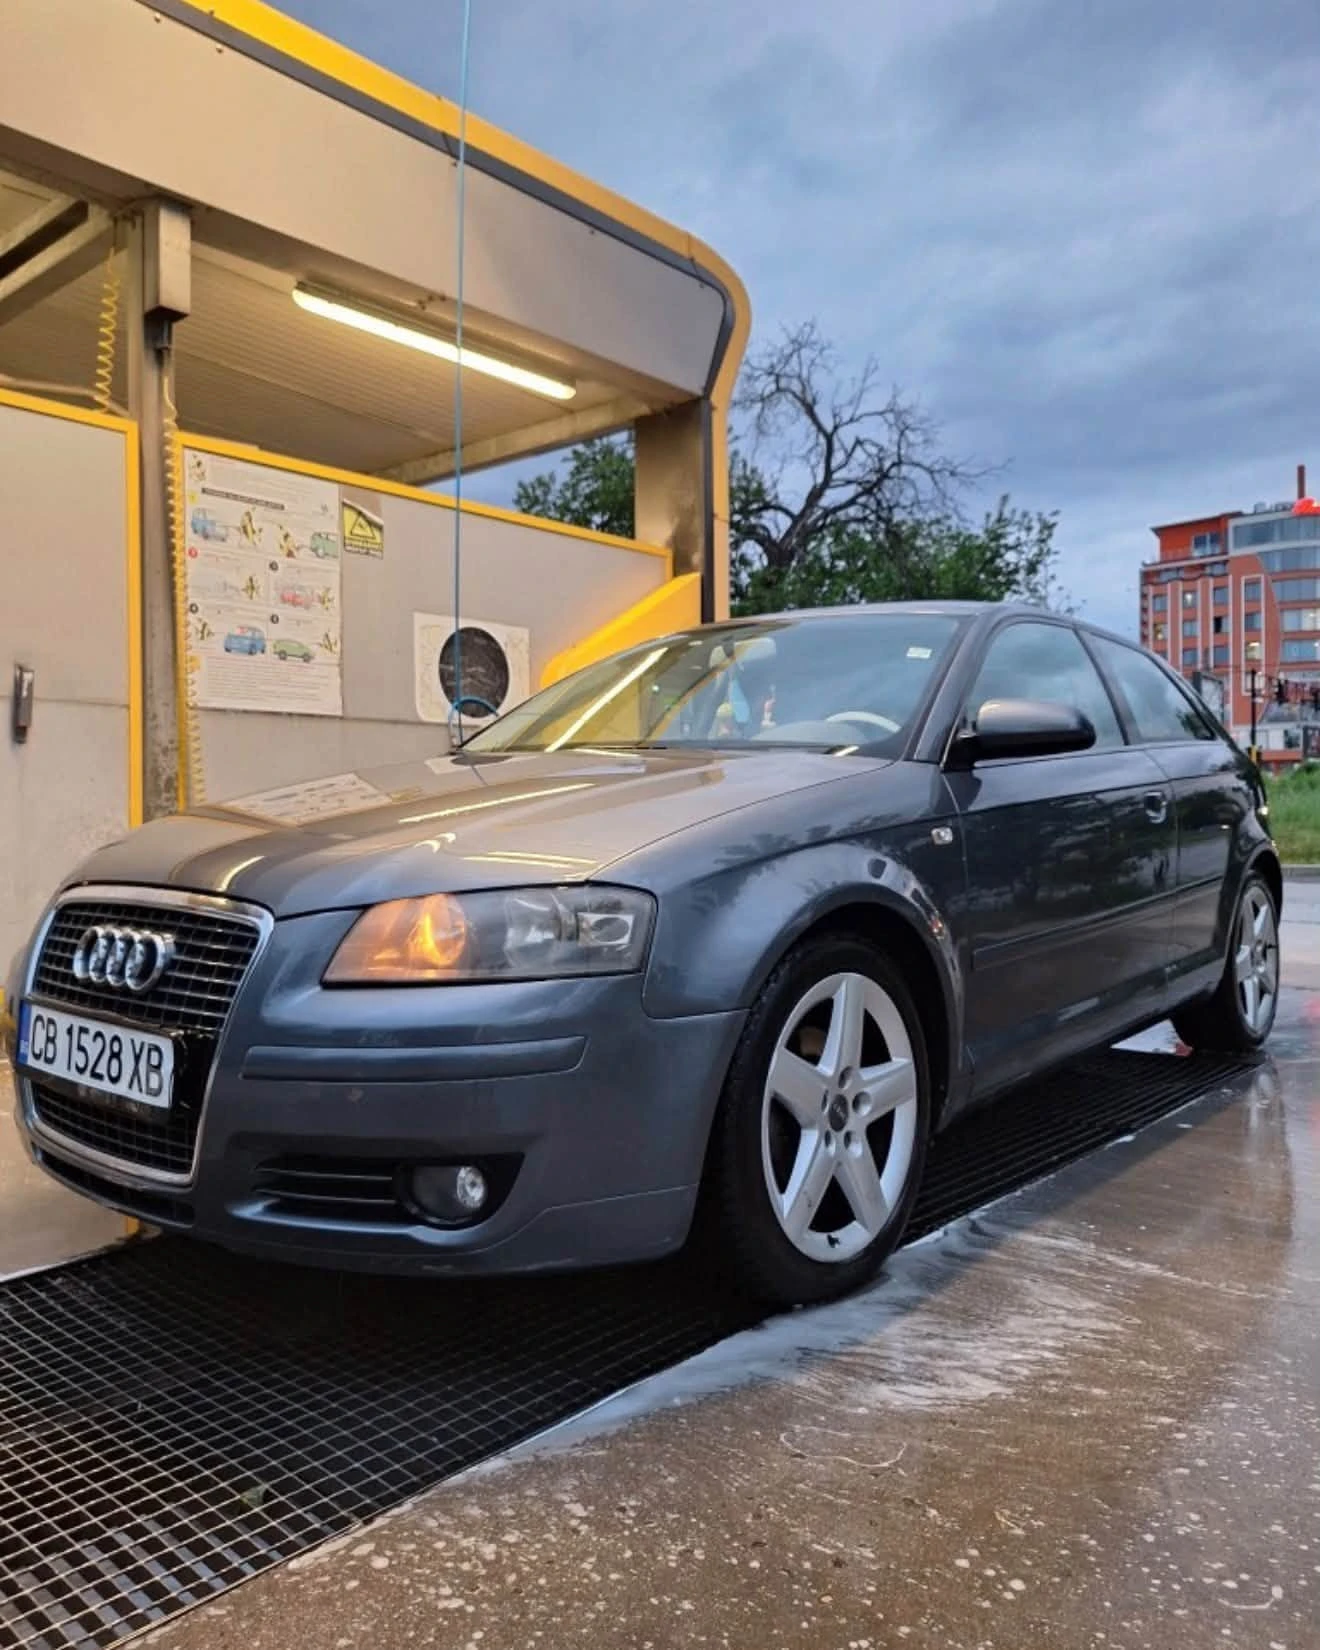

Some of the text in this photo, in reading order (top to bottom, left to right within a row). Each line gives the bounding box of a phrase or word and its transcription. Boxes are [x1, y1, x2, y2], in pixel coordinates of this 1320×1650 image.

[31, 1013, 164, 1097] CB 1528 XB
